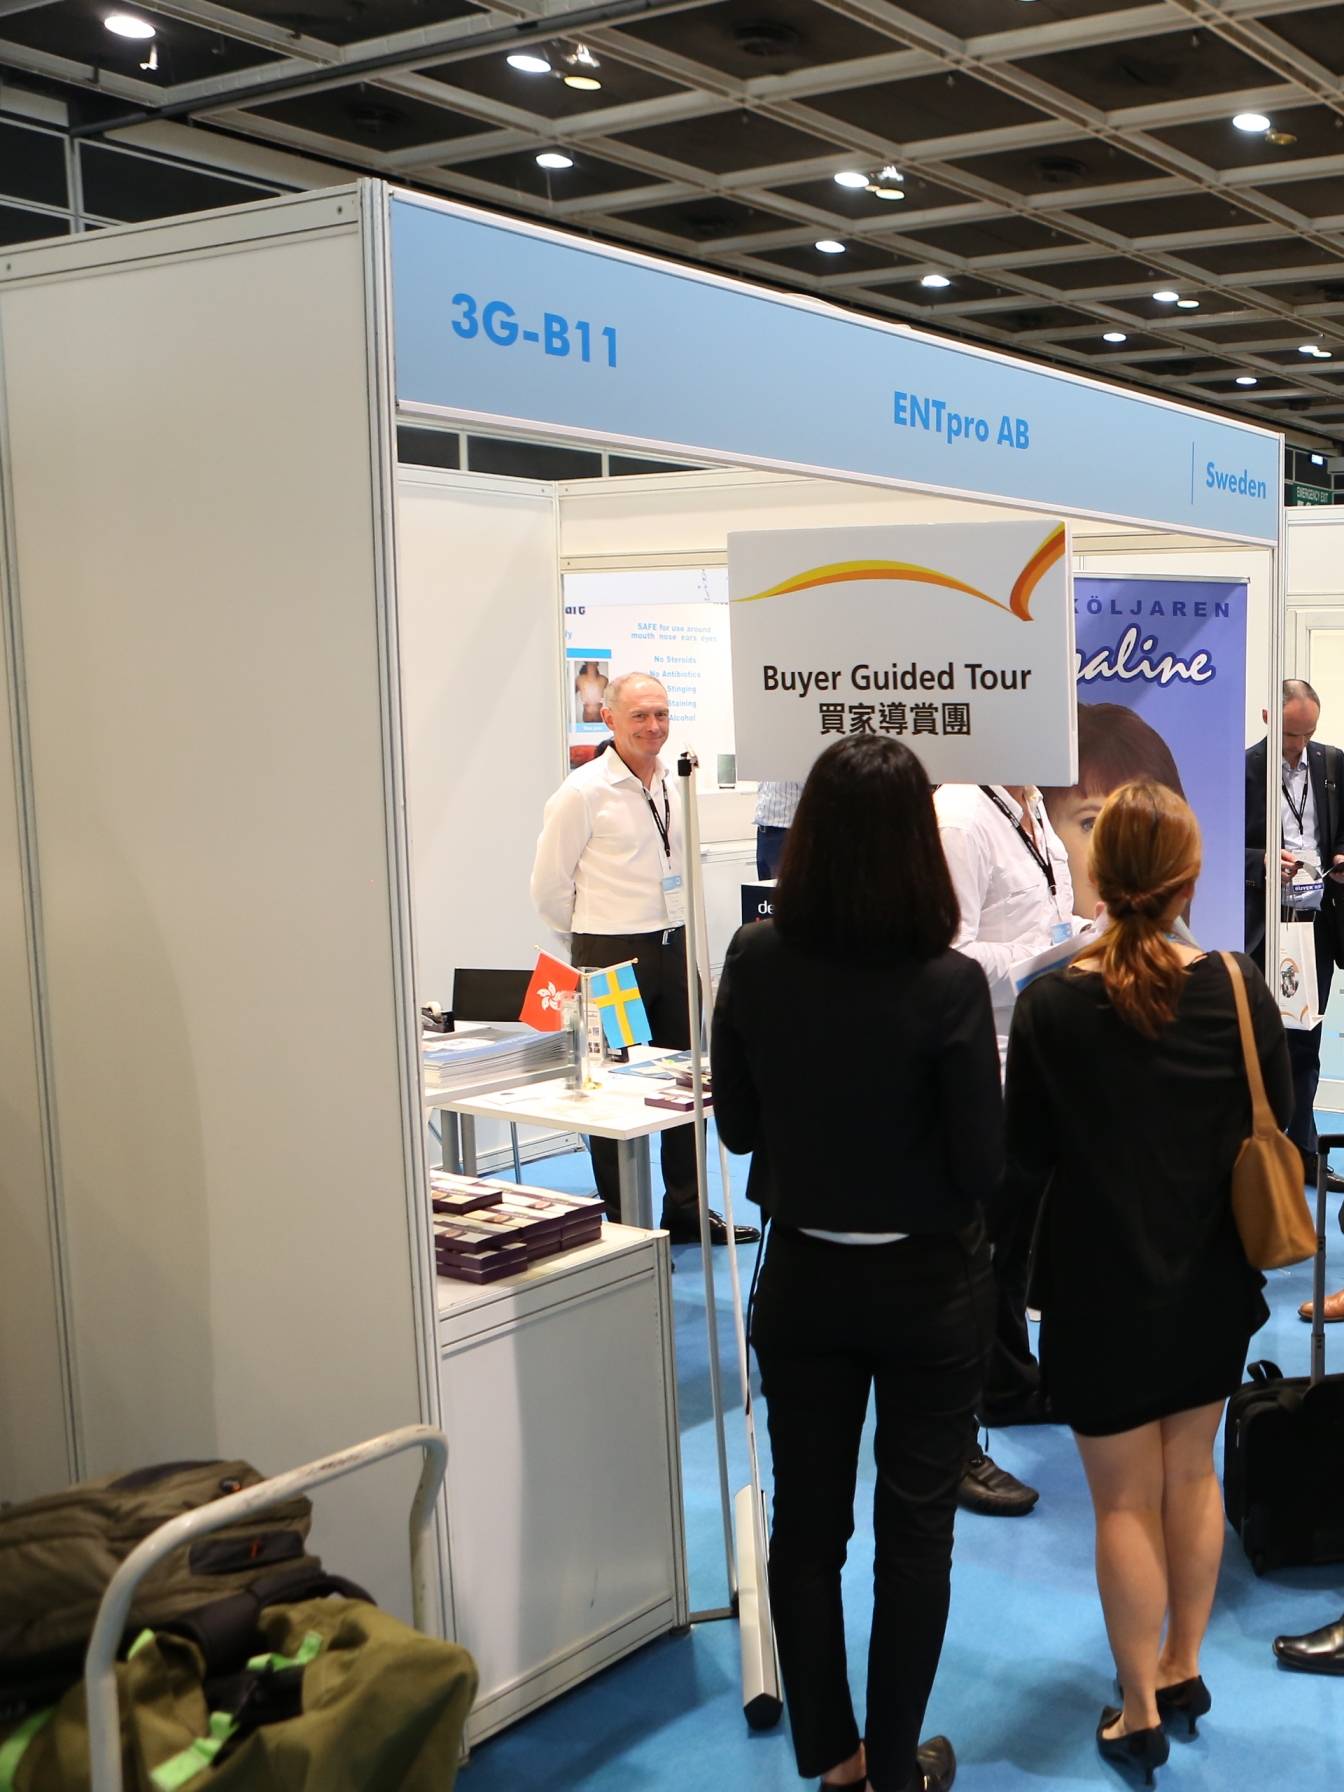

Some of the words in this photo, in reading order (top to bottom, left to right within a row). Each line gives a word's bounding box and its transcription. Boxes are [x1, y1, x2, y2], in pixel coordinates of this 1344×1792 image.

[451, 292, 617, 368] 3G-B11
[893, 390, 990, 444] ENTpro
[996, 415, 1030, 450] AB
[1205, 461, 1267, 499] Sweden
[631, 632, 655, 640] mouth
[637, 622, 657, 631] SAFE
[659, 624, 669, 632] for
[654, 655, 664, 663] No
[666, 655, 697, 664] Steroids
[662, 670, 702, 678] Antibiotics
[763, 665, 841, 697] Buyer
[851, 662, 954, 690] Guided
[964, 664, 1032, 690] Tour
[818, 702, 971, 736] 買家導賞團
